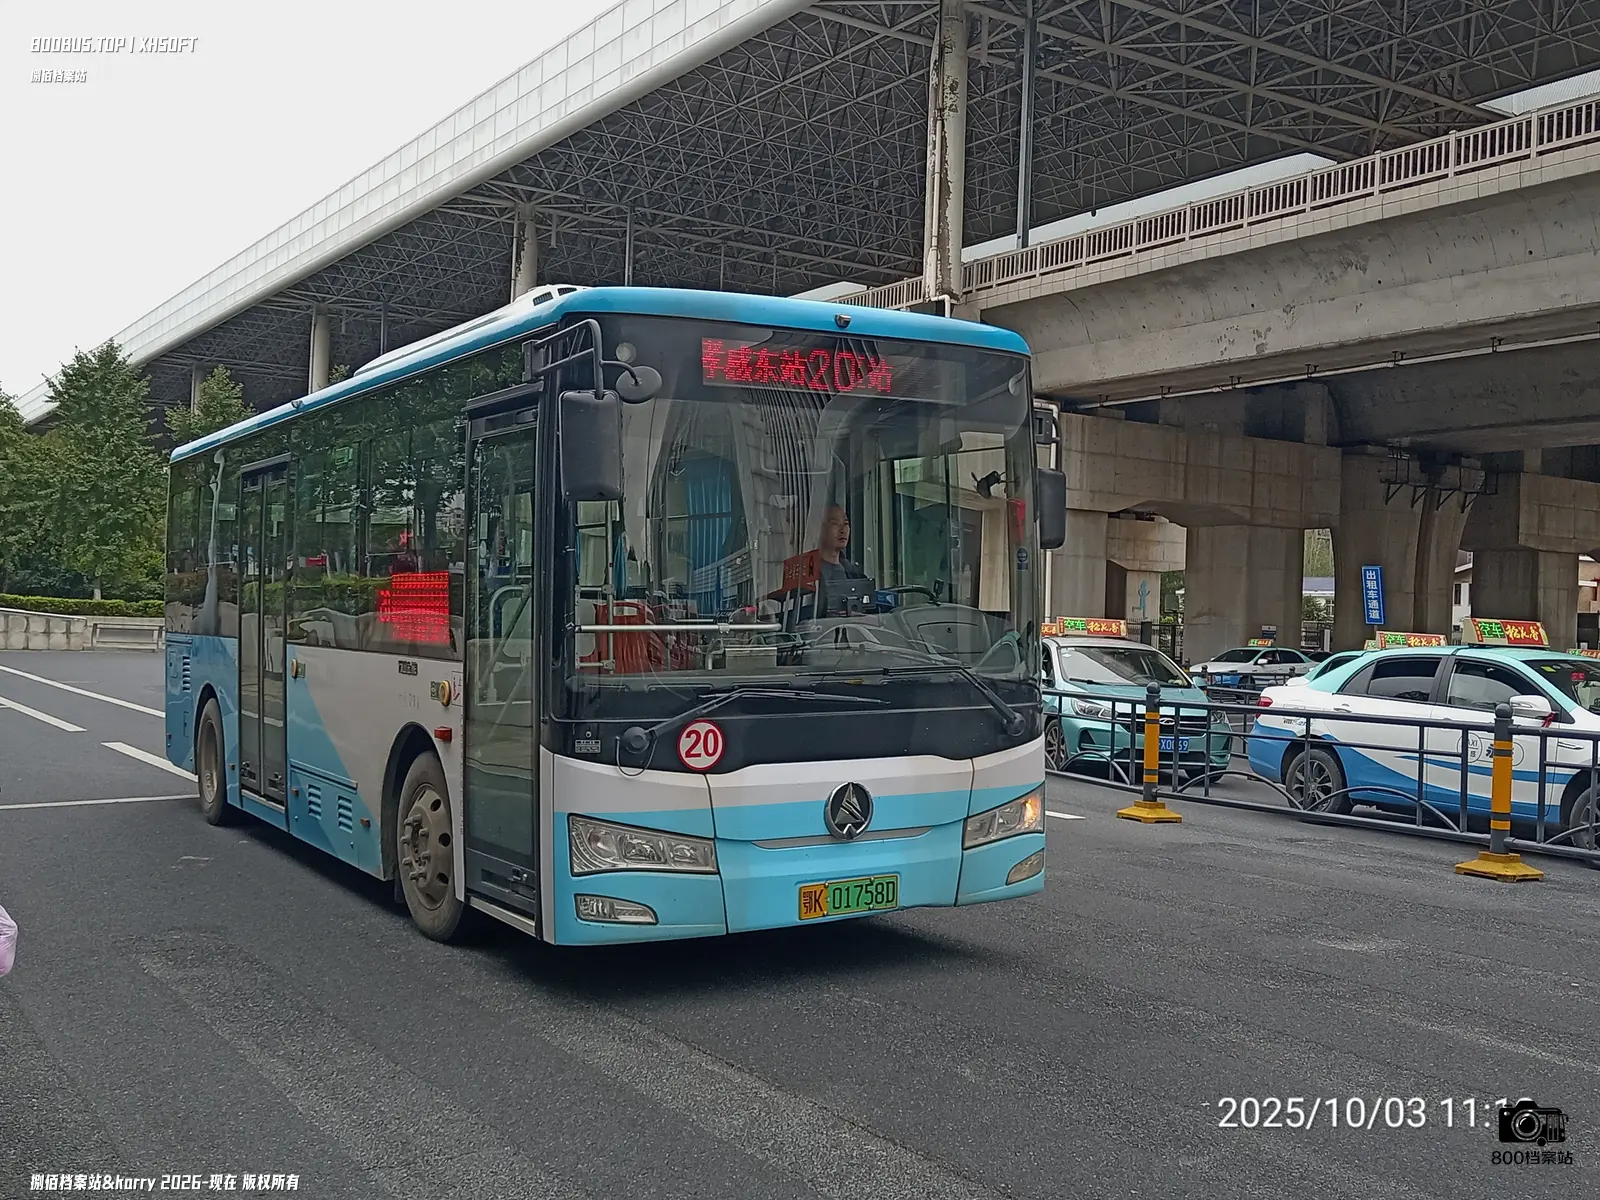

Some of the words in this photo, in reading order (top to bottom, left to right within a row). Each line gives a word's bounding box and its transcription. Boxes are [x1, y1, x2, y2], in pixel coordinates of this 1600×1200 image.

[1366, 570, 1380, 619] 出租车通道
[1064, 619, 1086, 631] 空车
[1479, 622, 1505, 638] 空车
[1385, 634, 1406, 645] 空车
[684, 728, 719, 758] 20
[802, 889, 824, 914] 鄂K
[832, 881, 896, 910] 01758D
